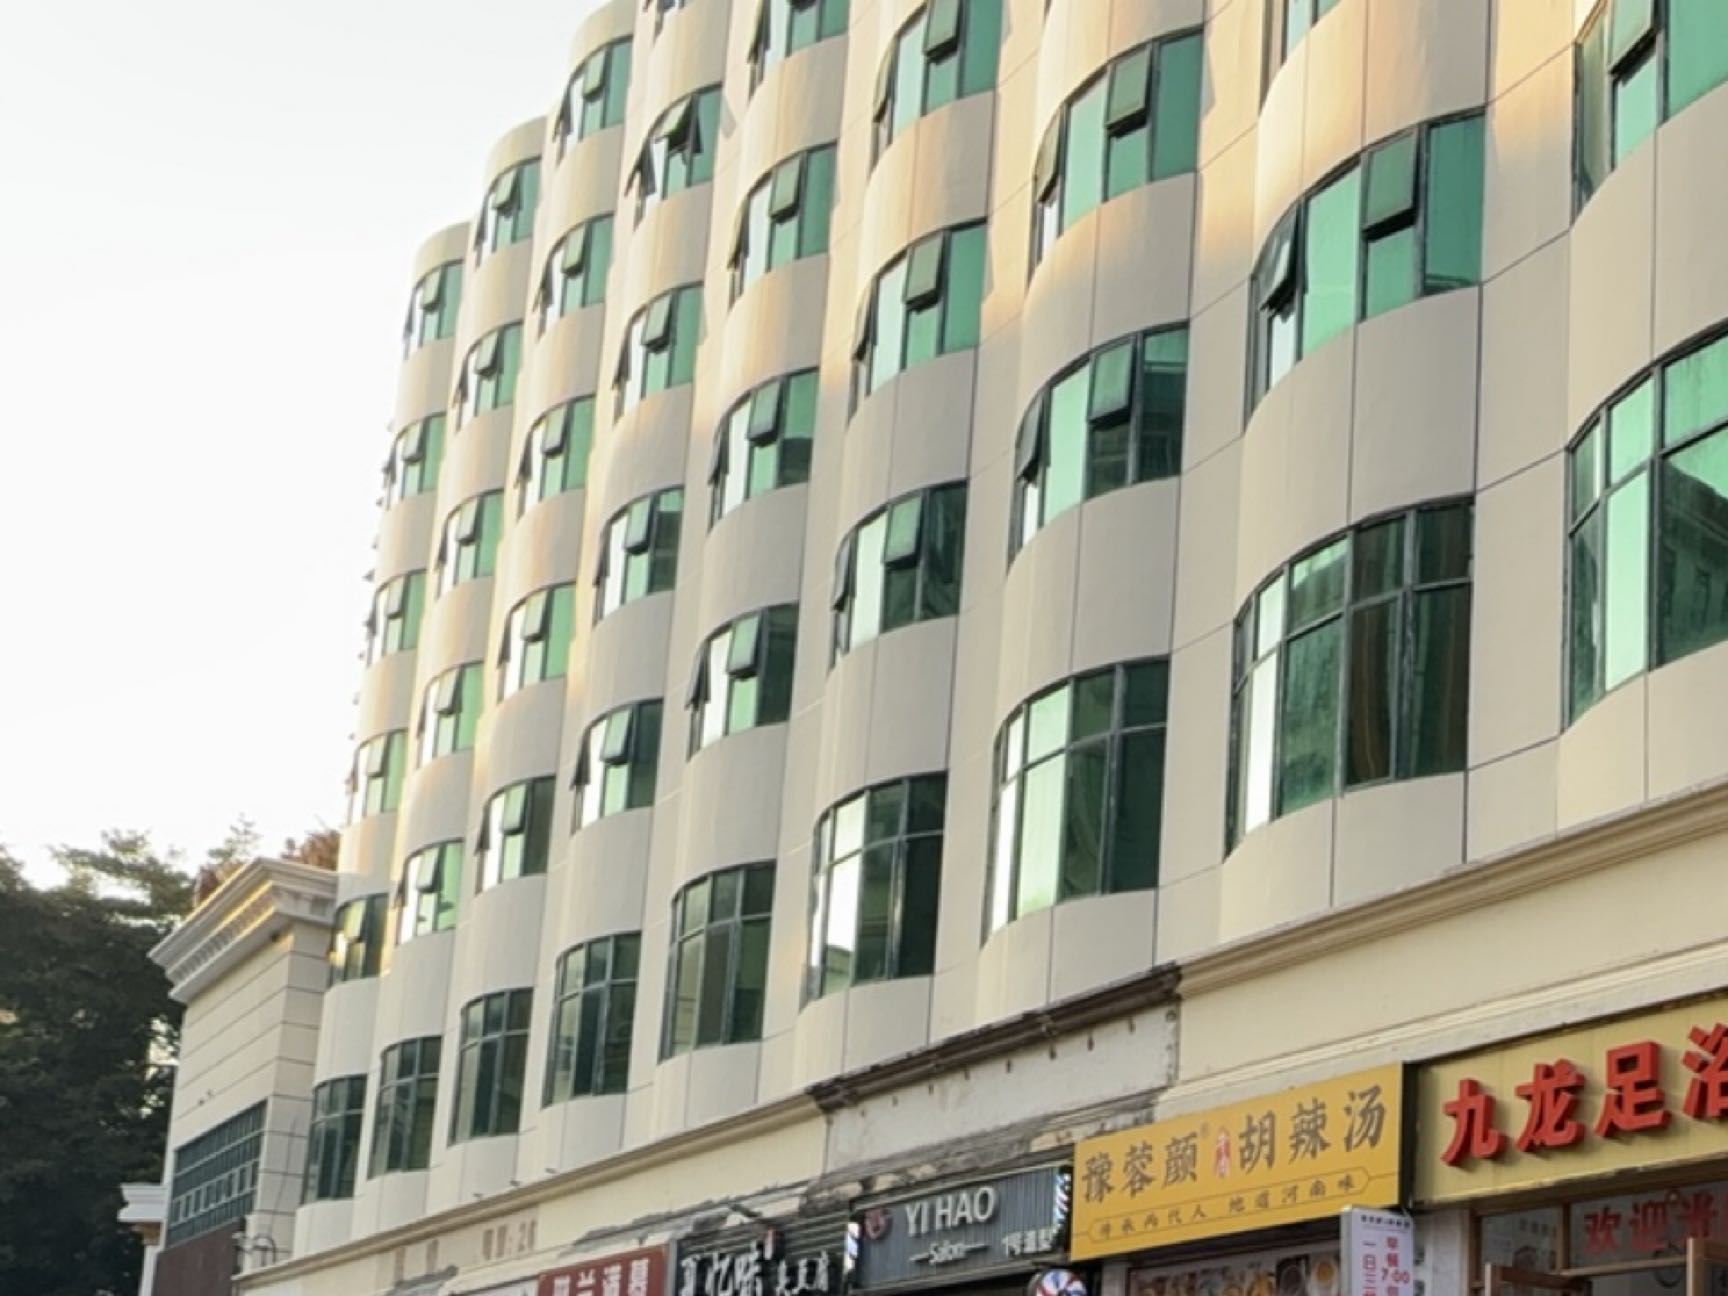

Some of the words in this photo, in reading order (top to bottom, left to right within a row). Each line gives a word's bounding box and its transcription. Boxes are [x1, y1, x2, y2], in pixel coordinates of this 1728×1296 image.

[1239, 1085, 1386, 1174] 胡辣汤
[905, 1202, 929, 1234] YI
[935, 1186, 995, 1230] HAO
